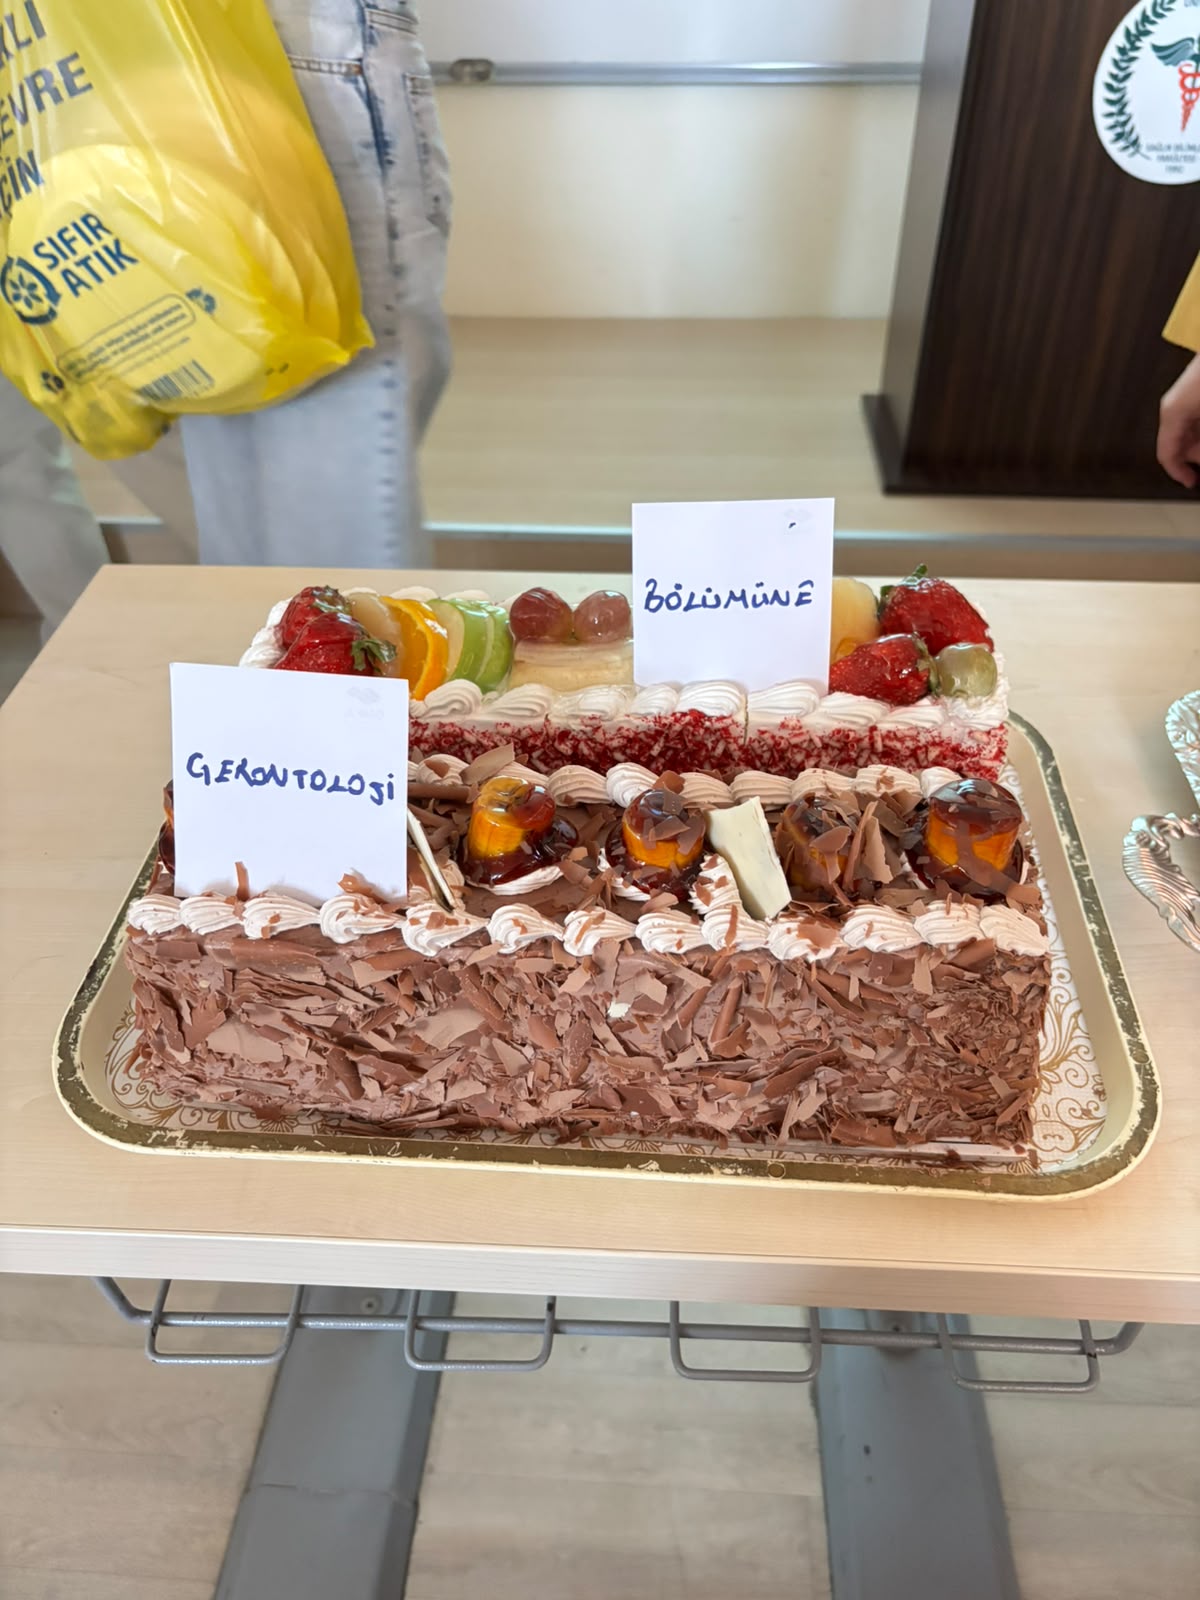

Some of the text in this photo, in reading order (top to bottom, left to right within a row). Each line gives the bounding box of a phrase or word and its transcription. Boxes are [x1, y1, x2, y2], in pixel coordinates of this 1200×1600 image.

[0, 51, 93, 143] EVRE
[0, 149, 44, 219] ÇİN
[33, 212, 113, 270] SIFIR
[60, 238, 138, 298] ATIK
[643, 578, 815, 614] BÖLÜMÜNE
